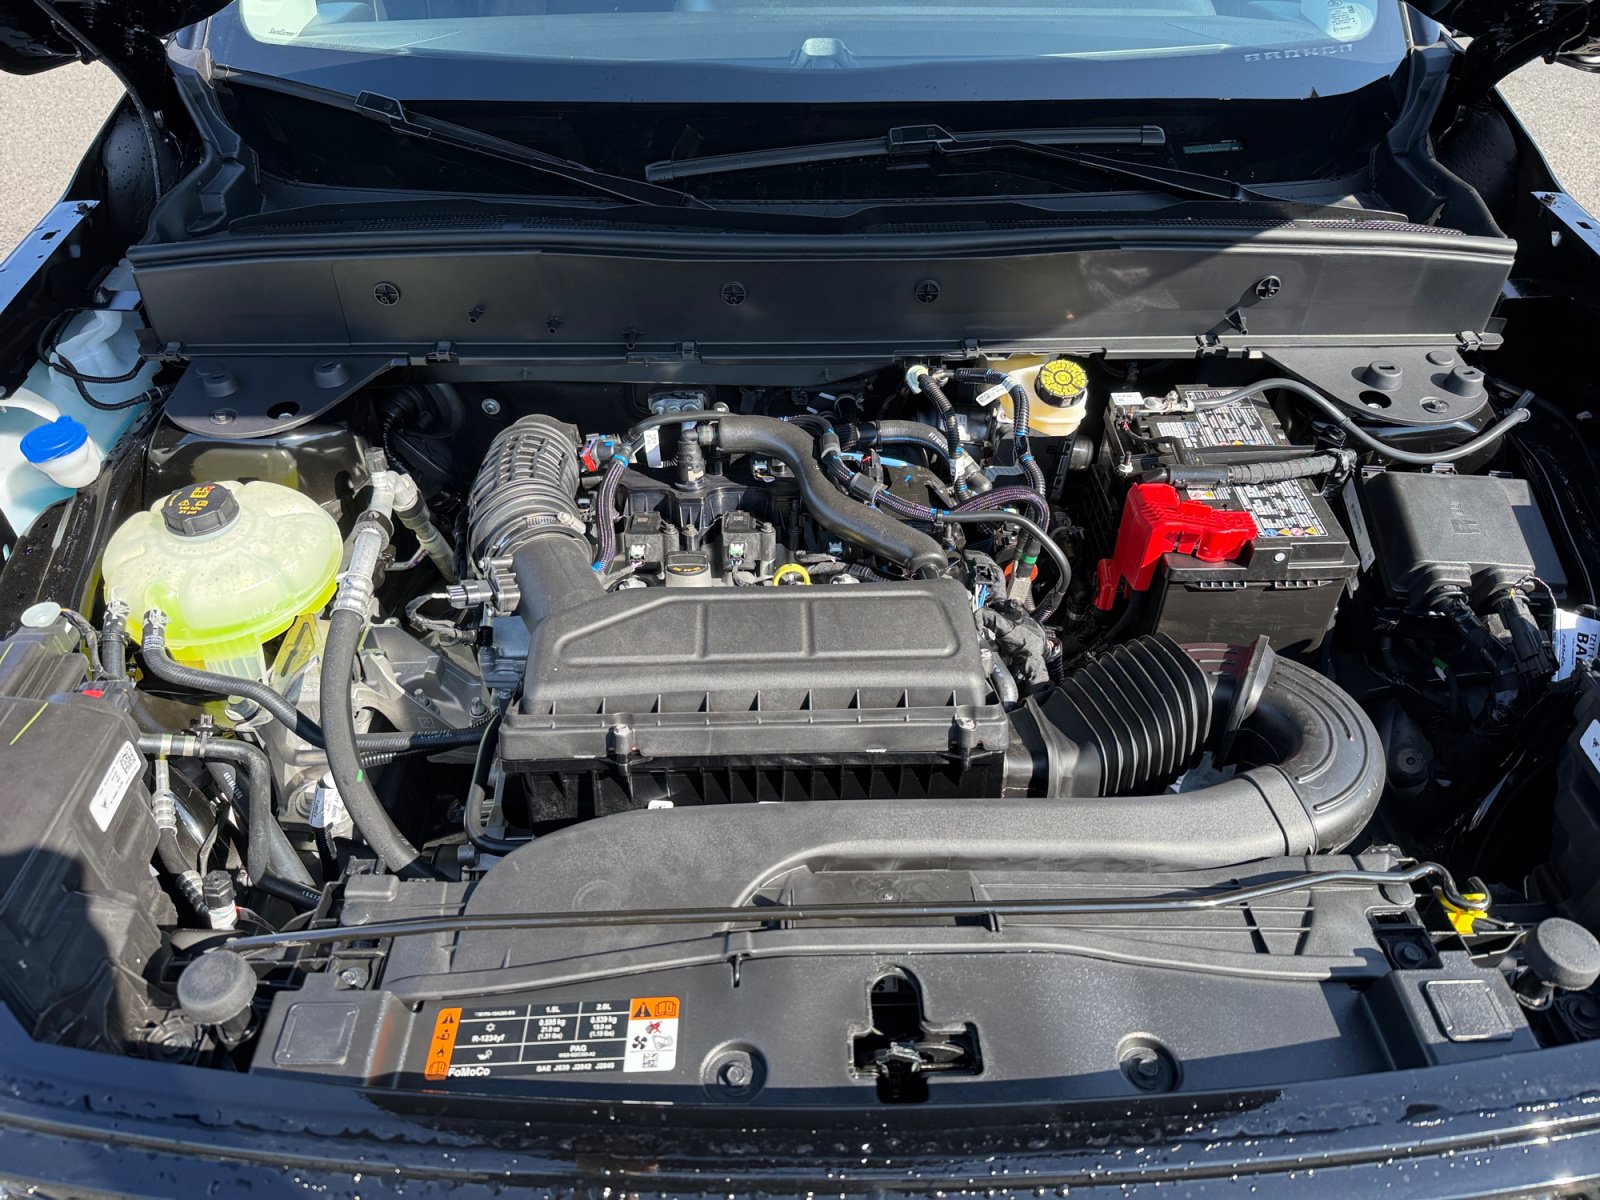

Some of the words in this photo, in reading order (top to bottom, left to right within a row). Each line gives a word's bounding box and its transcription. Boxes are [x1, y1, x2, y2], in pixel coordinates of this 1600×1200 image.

[1243, 43, 1353, 63] BRONCO
[596, 1003, 612, 1011] 2.0L
[557, 1018, 566, 1027] kg
[608, 1016, 617, 1024] kg
[471, 1033, 506, 1043] R-1234yf
[569, 1044, 587, 1052] PAG
[448, 1066, 491, 1077] FoMoCo
